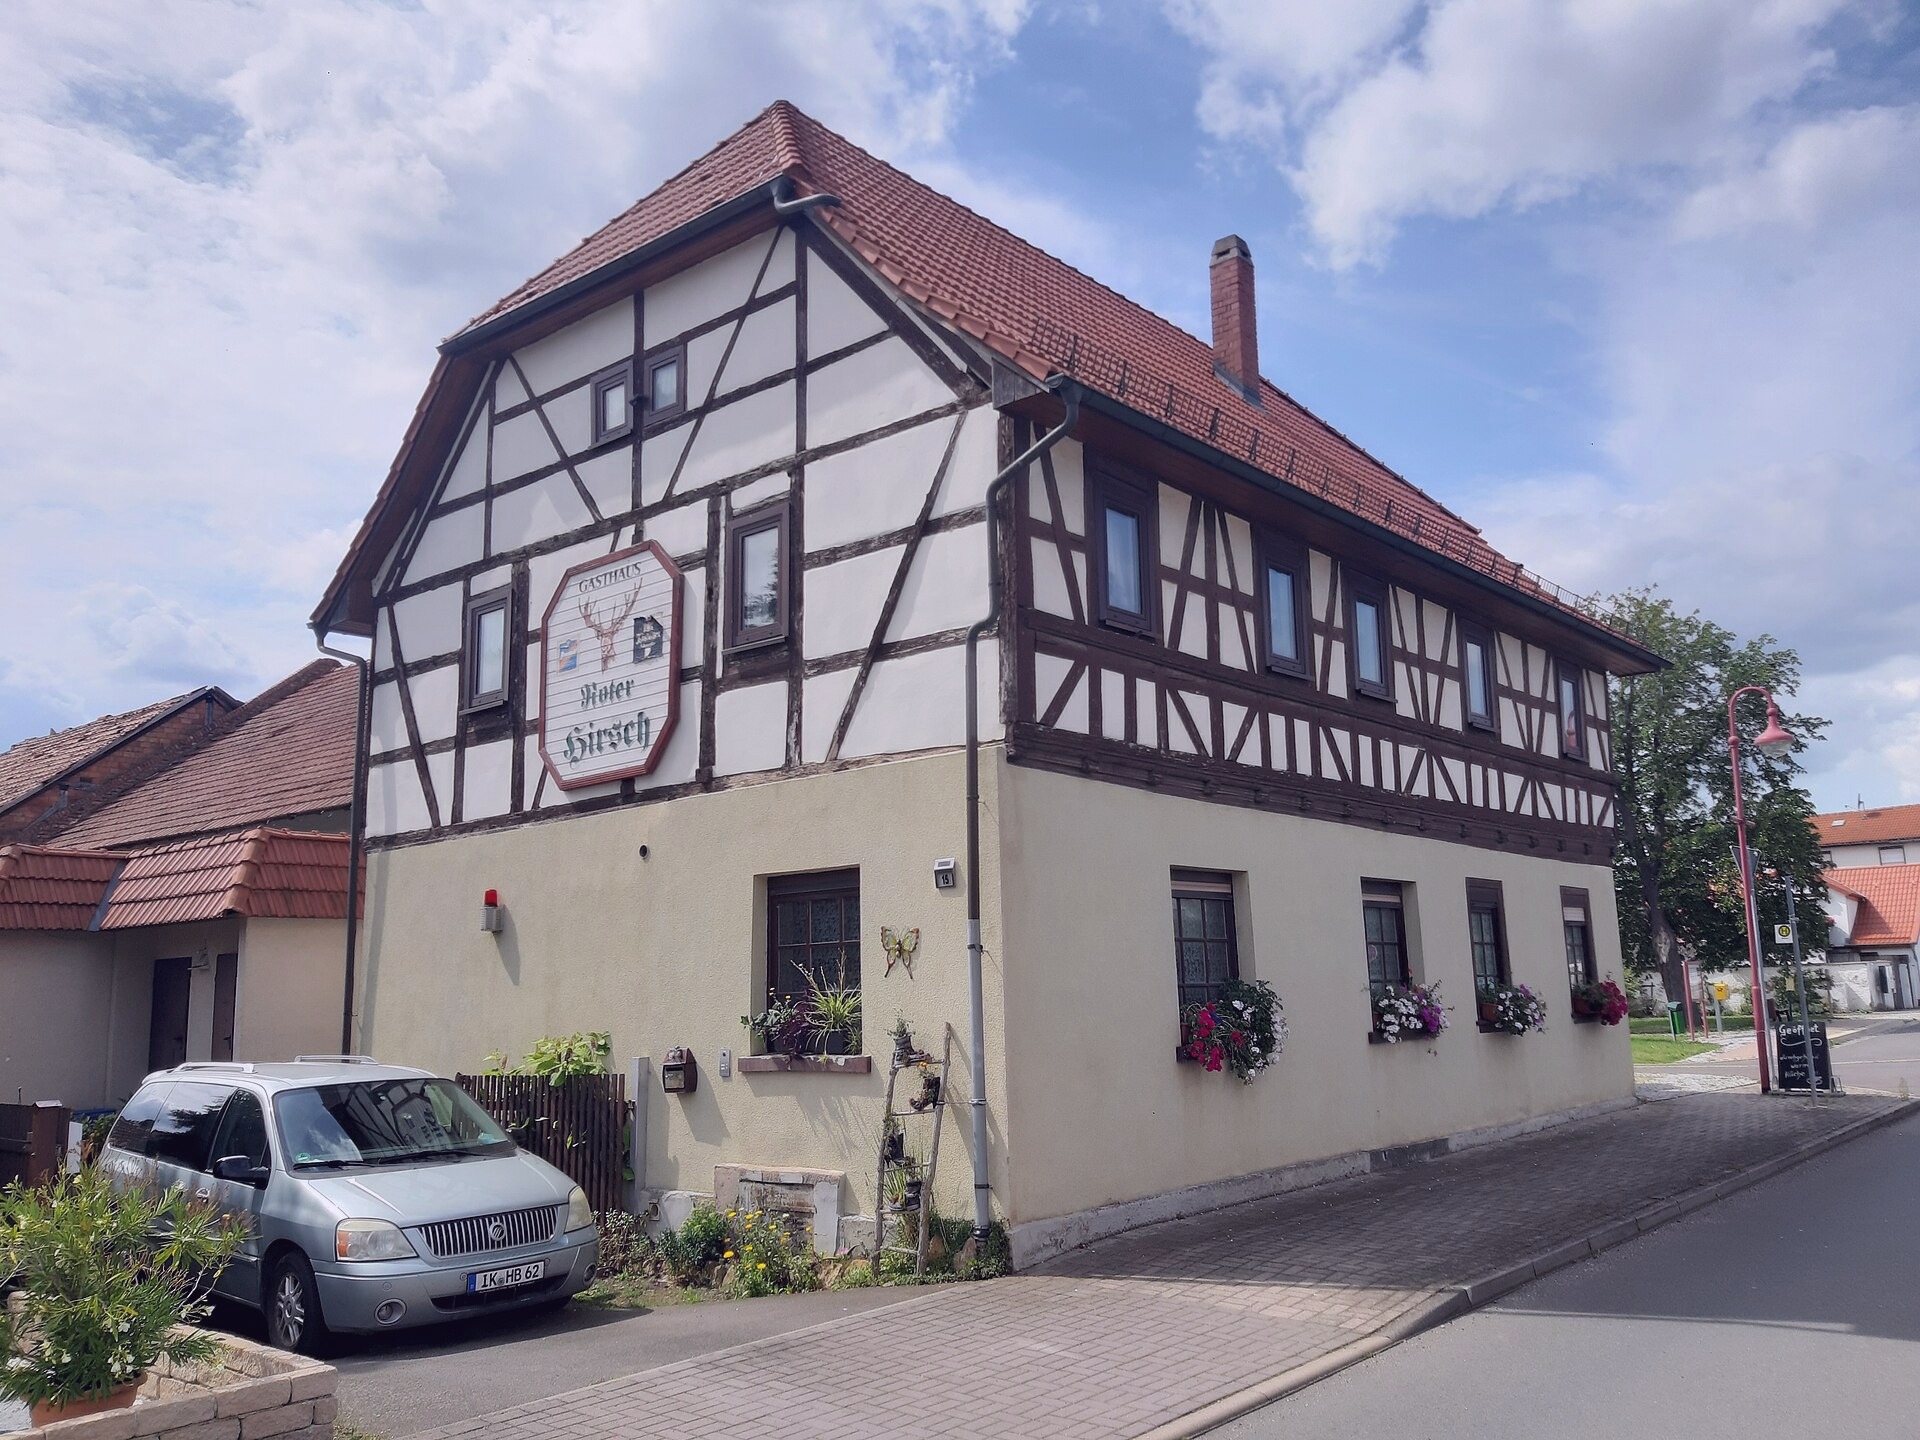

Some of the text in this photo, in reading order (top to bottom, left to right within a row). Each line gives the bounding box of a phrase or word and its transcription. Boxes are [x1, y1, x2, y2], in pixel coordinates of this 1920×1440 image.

[579, 562, 641, 592] GASTHAUS
[580, 680, 634, 708] Roter
[563, 711, 650, 770] Hirsch
[941, 874, 949, 885] 15
[1779, 1024, 1820, 1036] Geöffet
[481, 1272, 498, 1288] IK
[505, 1268, 521, 1283] HB
[525, 1265, 539, 1279] 62
